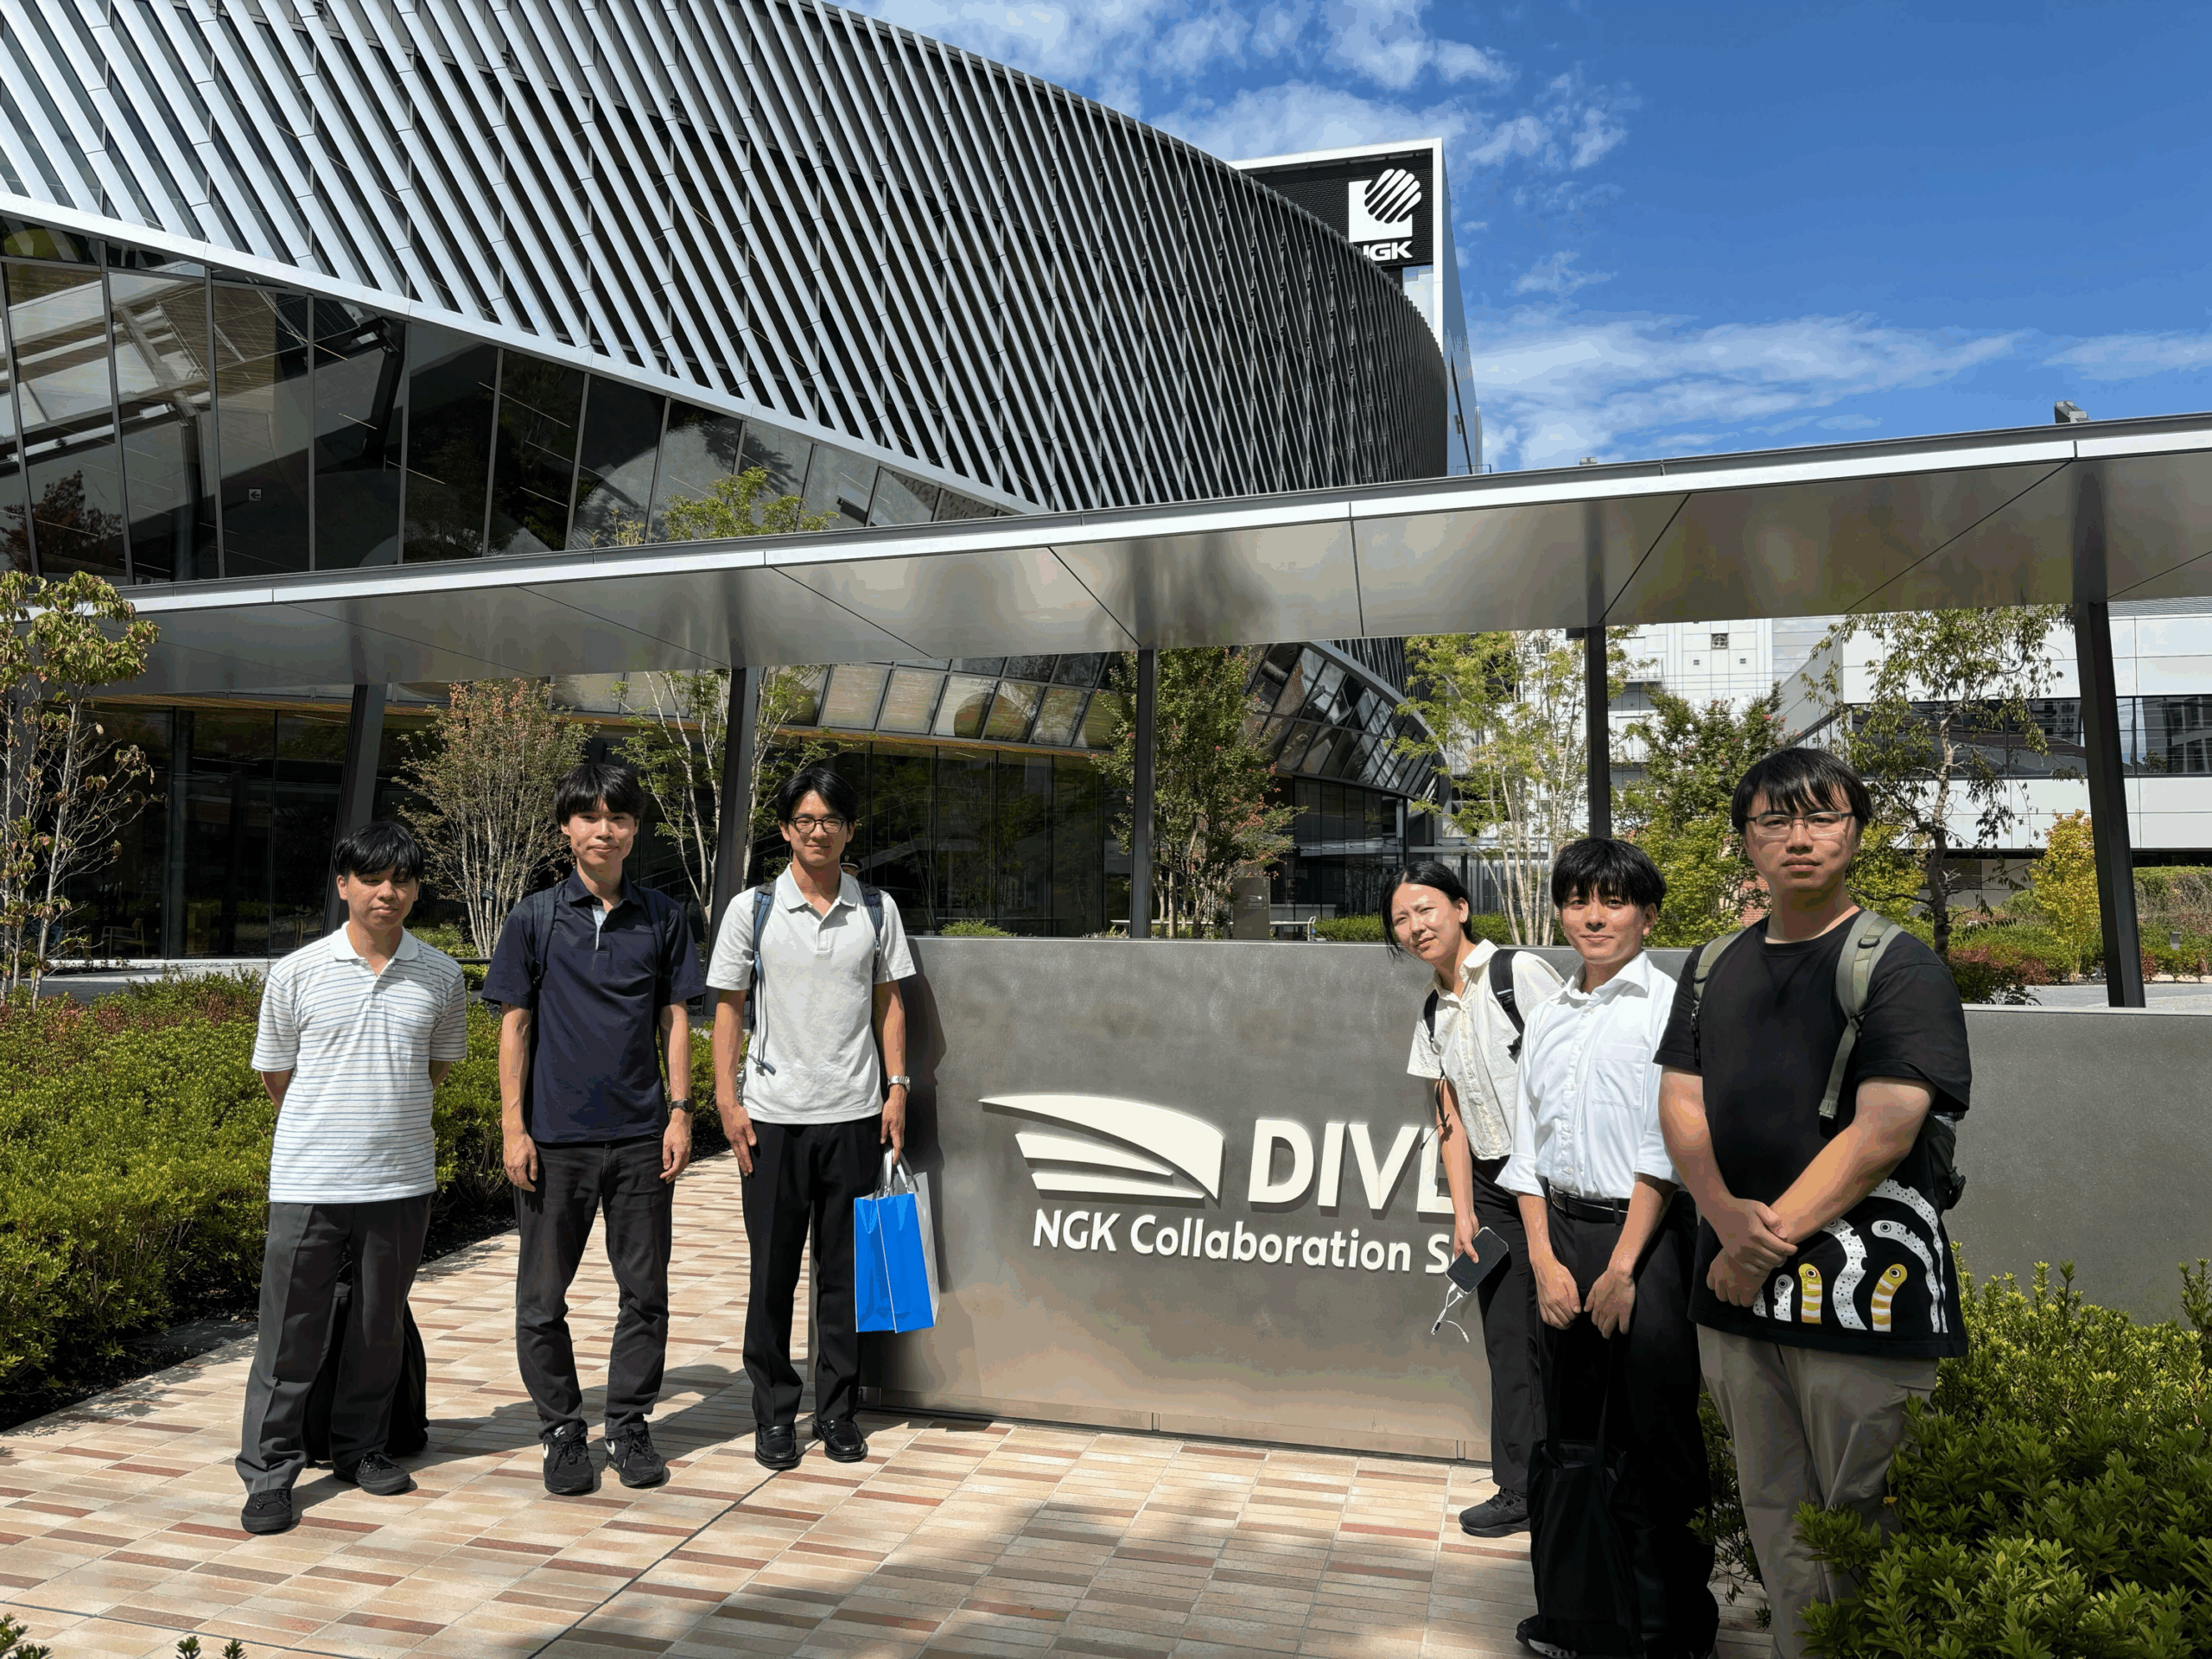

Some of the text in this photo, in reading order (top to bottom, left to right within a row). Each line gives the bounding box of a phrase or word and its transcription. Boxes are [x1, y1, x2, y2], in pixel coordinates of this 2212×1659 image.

[1363, 240, 1413, 261] GK
[1033, 1209, 1456, 1274] NGK Collaboration S
